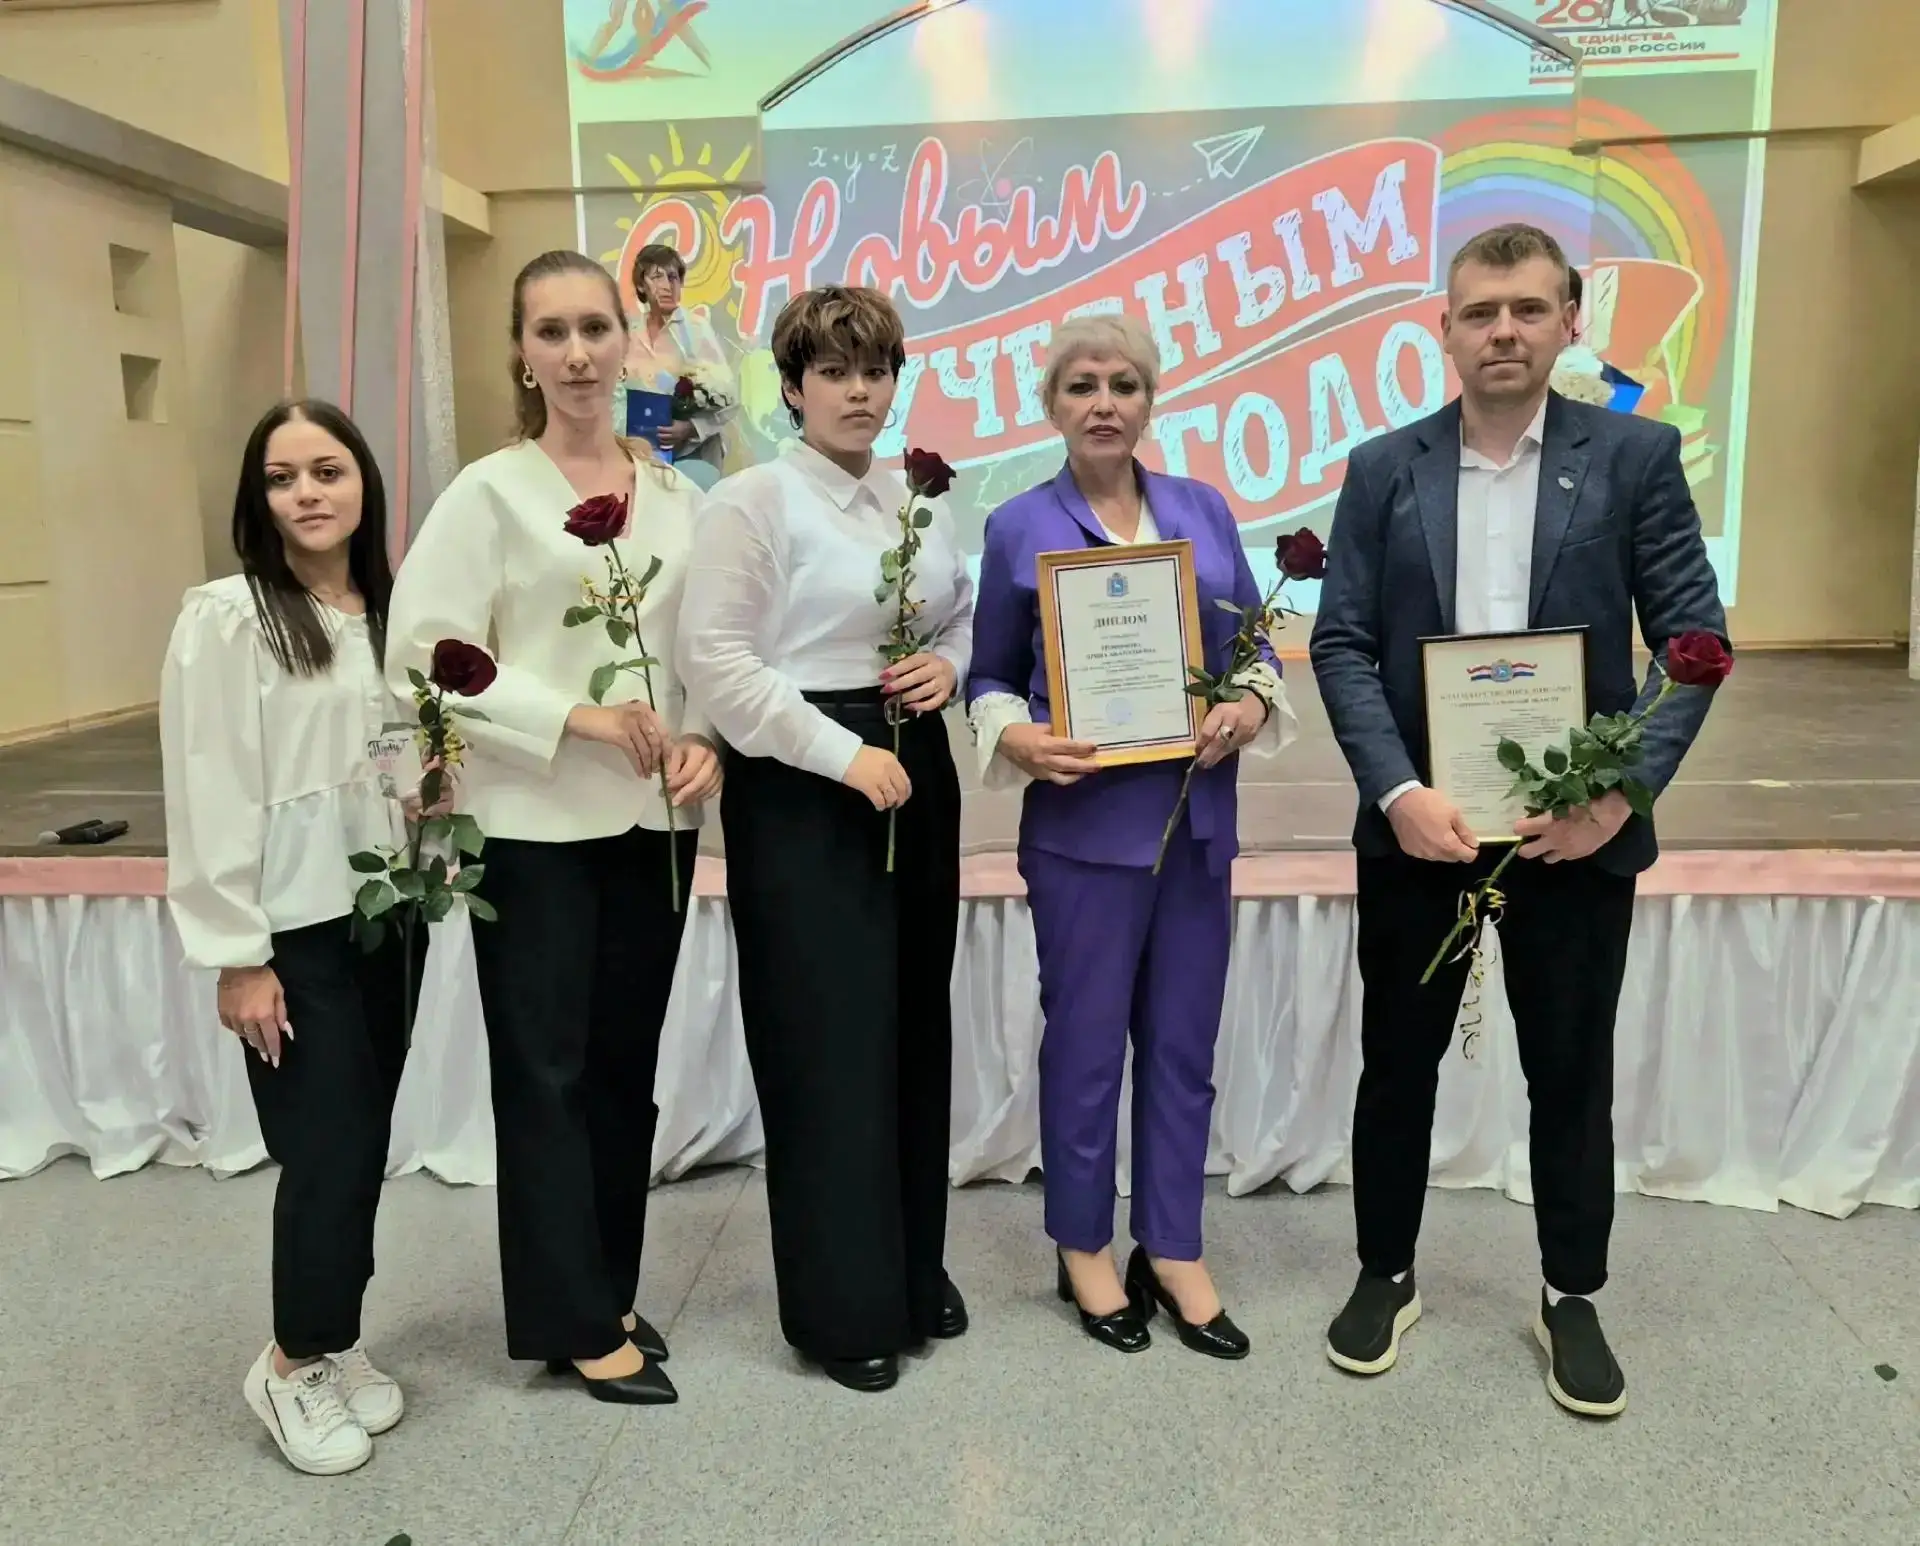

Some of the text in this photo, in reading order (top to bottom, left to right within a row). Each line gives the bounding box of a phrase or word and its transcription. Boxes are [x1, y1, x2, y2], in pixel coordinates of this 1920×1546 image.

[1577, 31, 1677, 45] ЕДИНСТВА
[1628, 41, 1706, 55] РОССИИ
[870, 159, 1420, 459] УЧЕНЫМ
